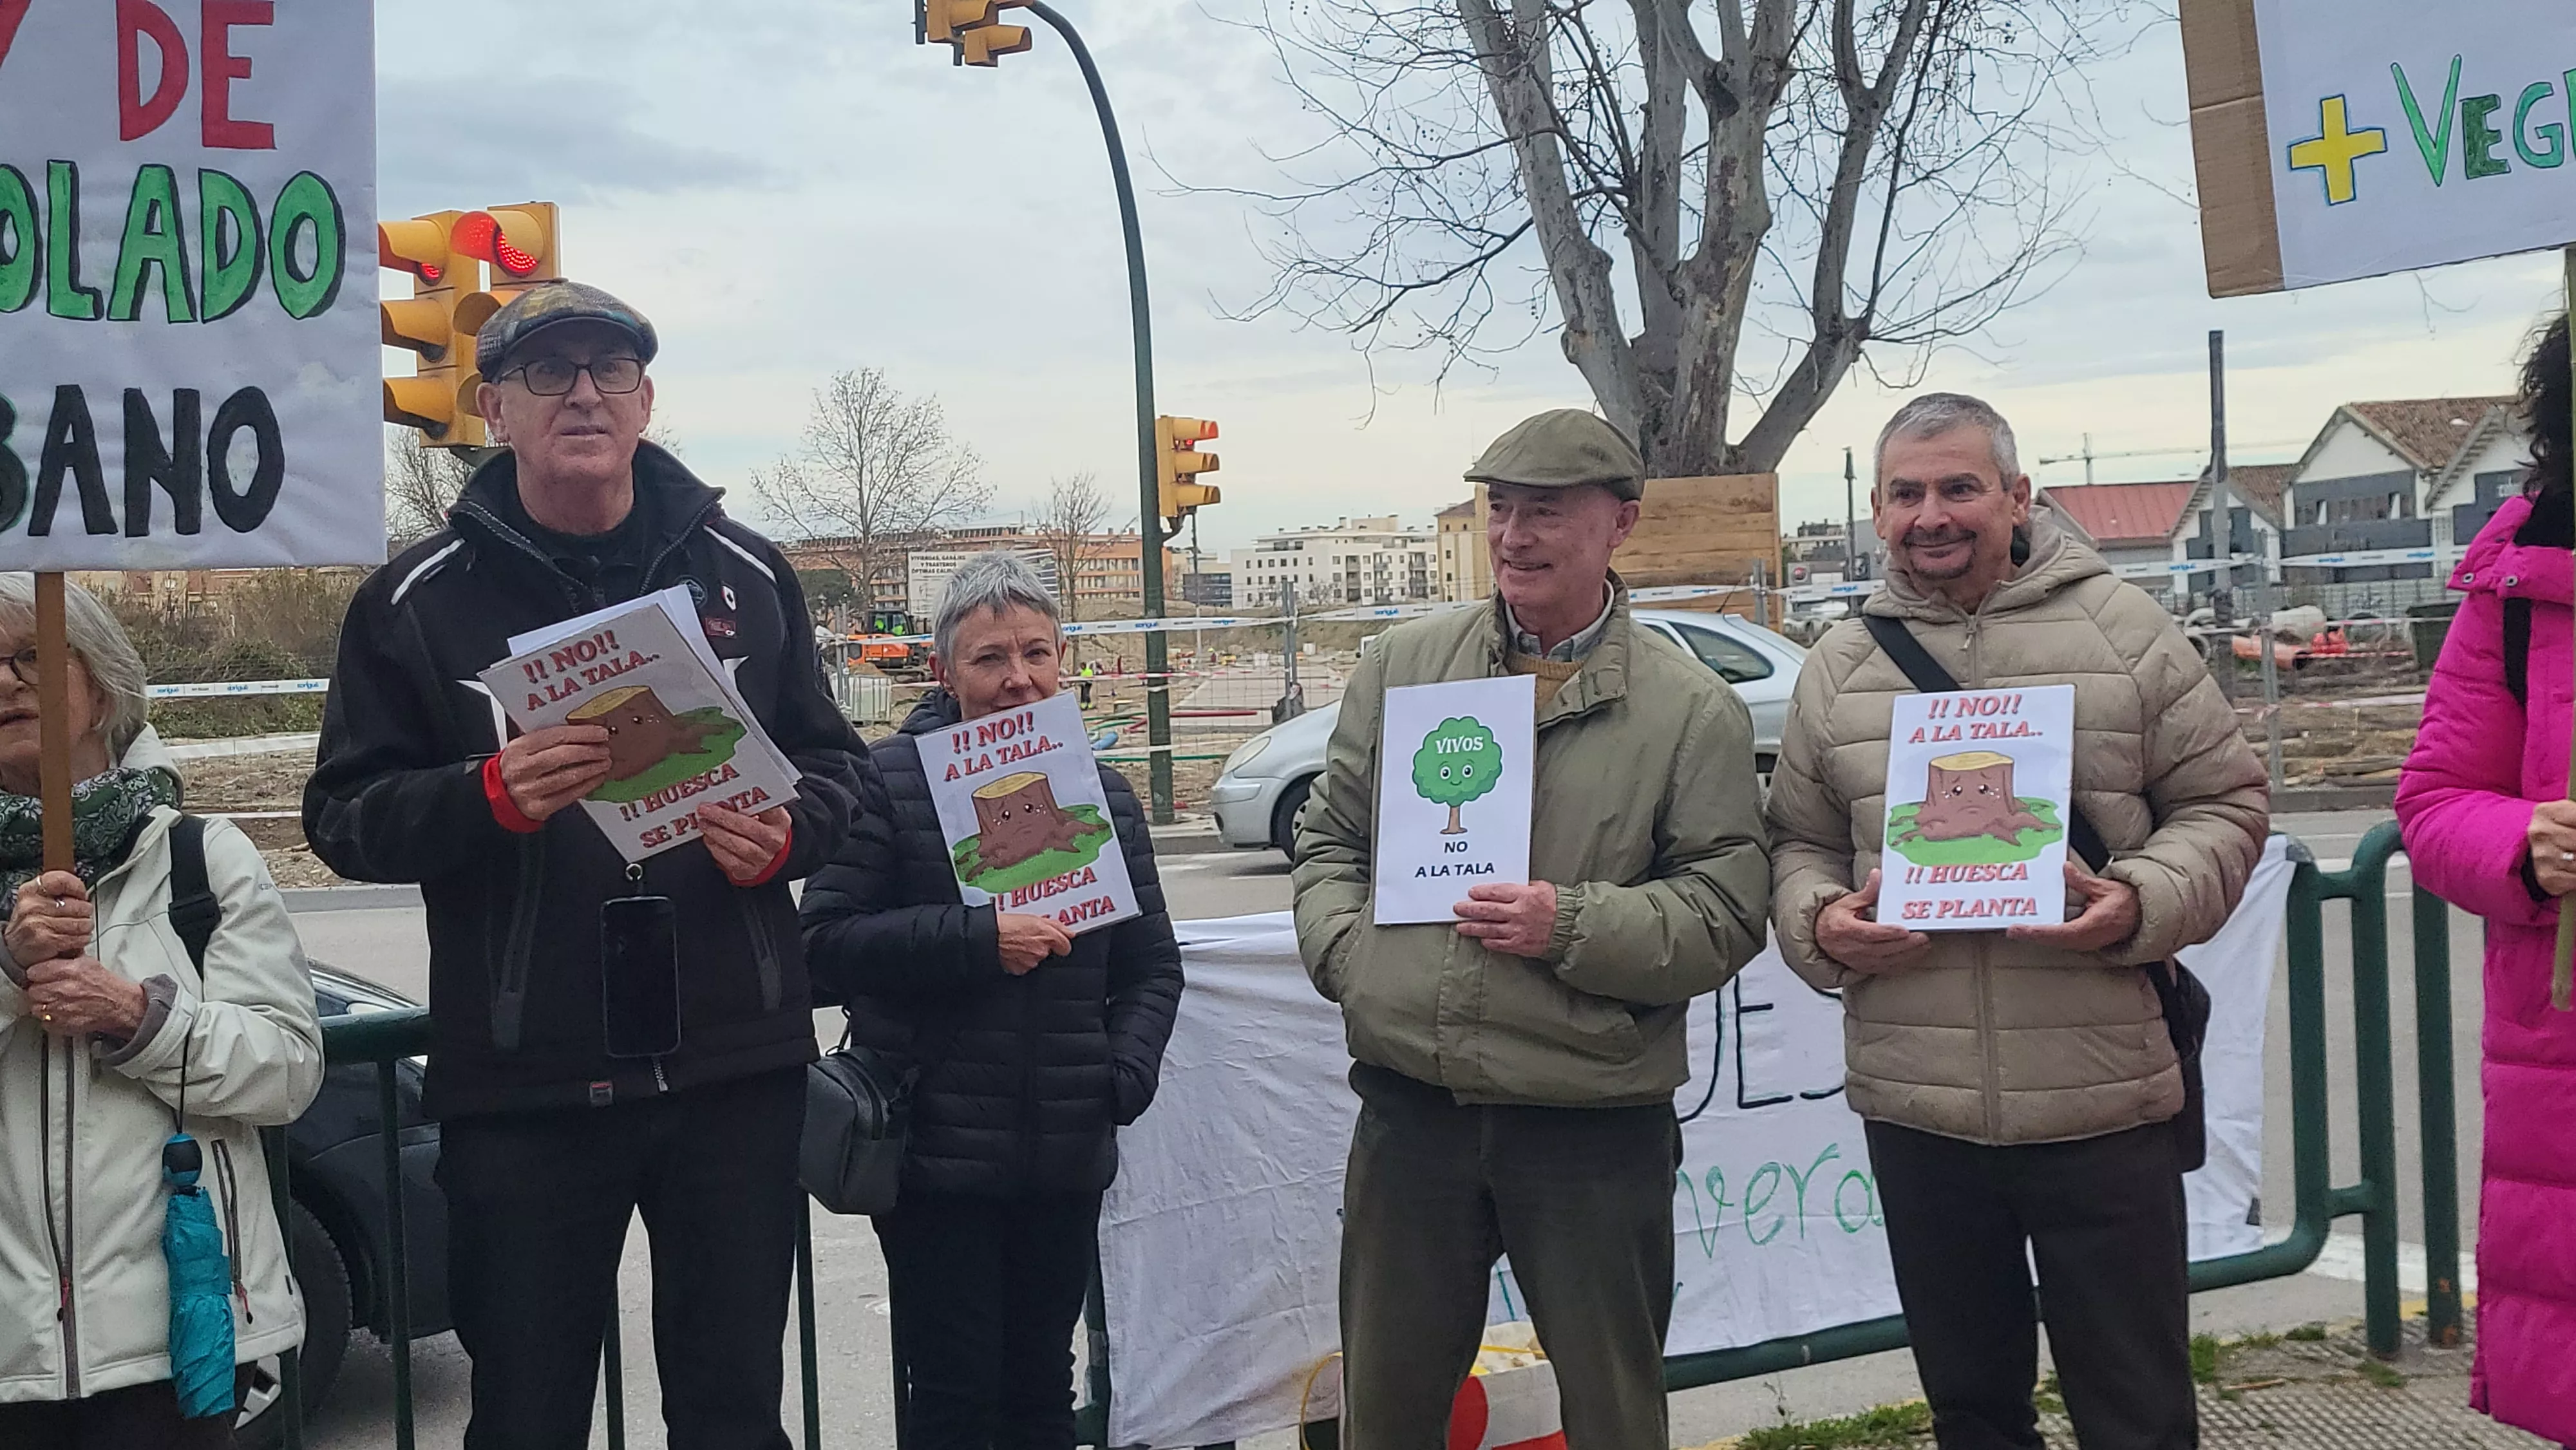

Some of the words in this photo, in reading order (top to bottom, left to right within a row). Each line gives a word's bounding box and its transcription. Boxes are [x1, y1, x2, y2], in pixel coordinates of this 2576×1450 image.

[117, 0, 278, 150] DE
[549, 629, 620, 672] NO!!
[527, 693, 547, 711] A
[544, 677, 582, 702] LA
[1954, 693, 2022, 718] NO!!
[976, 711, 1034, 747] NO!!
[1908, 727, 1926, 744] A
[1931, 724, 1962, 742] LA
[1435, 735, 1484, 755] VIVOS
[943, 764, 961, 782] A
[963, 753, 994, 775] LA
[643, 763, 740, 813] HUESCA
[639, 825, 672, 848] SE
[1444, 841, 1468, 854] NO
[1415, 865, 1427, 878] A
[1431, 864, 1451, 877] LA
[1454, 862, 1495, 876] TALA
[1928, 863, 2028, 883] HUESCA
[1010, 866, 1097, 907] HUESCA
[1042, 895, 1116, 927] ANTA
[1902, 899, 1931, 920] SE
[1935, 898, 2038, 918] PLANTA
